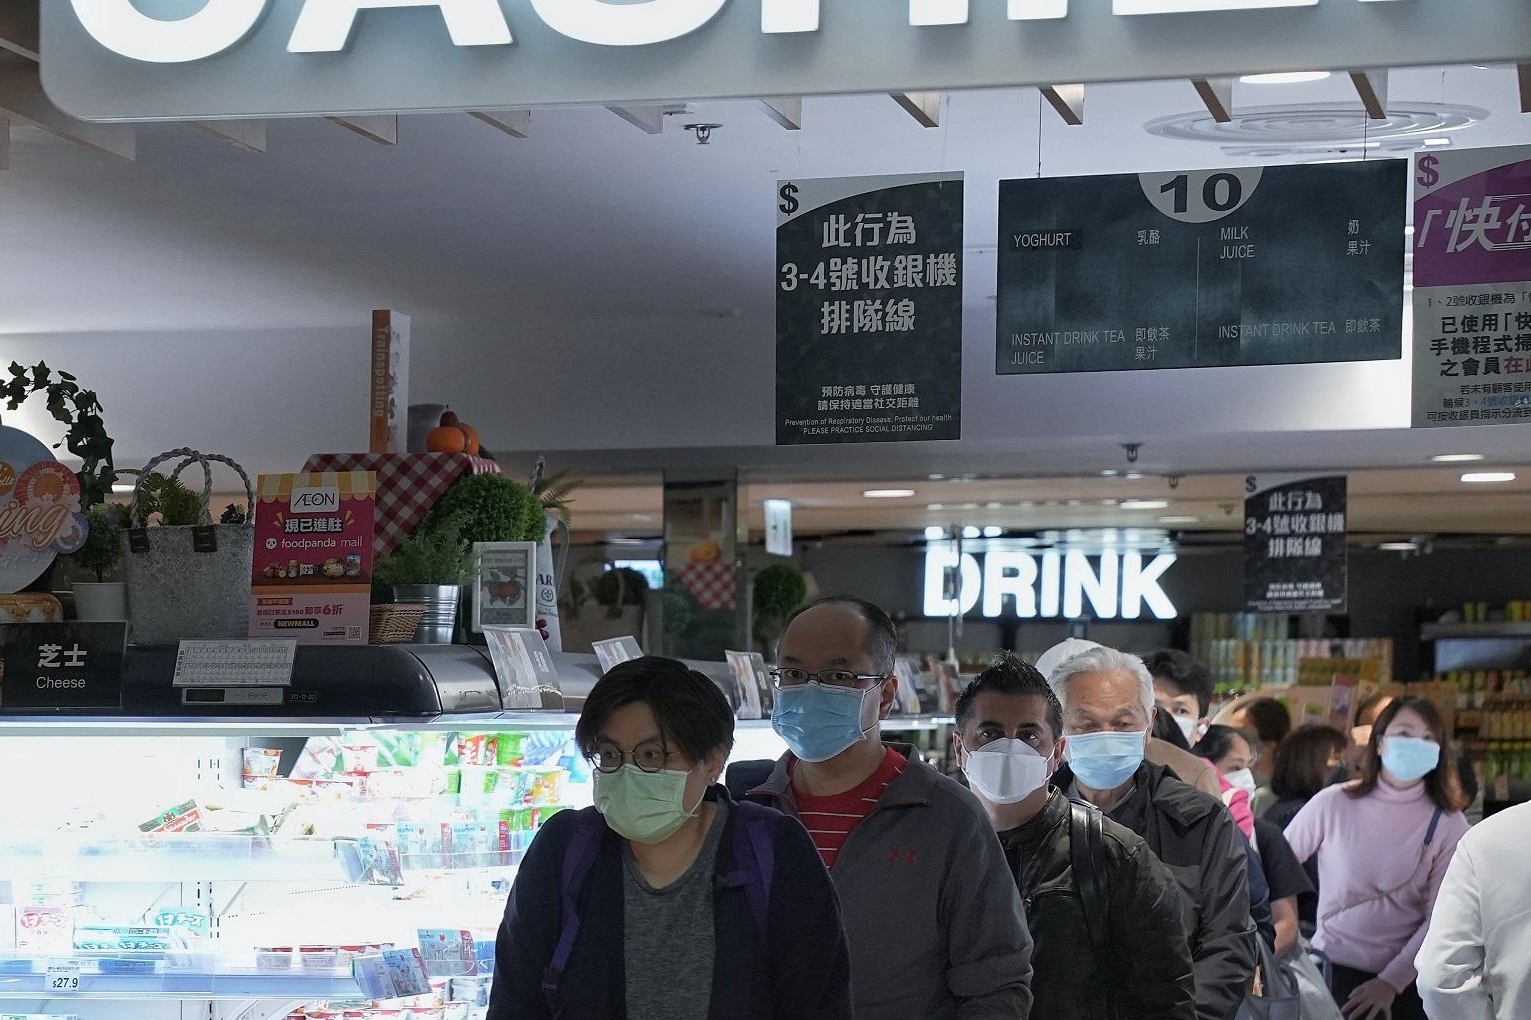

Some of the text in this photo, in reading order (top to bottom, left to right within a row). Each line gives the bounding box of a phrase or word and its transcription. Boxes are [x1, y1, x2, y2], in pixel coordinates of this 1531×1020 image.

[1417, 153, 1439, 189] $
[779, 182, 799, 216] $
[1160, 172, 1242, 213] 10
[822, 212, 917, 248] 此行為
[1221, 226, 1249, 241] MILK
[1347, 219, 1359, 236] 奶
[1013, 232, 1071, 247] YOGHURT
[1137, 229, 1160, 246] 乳酪
[1220, 245, 1255, 259] JUICE
[1347, 240, 1371, 256] 果汁
[781, 253, 957, 291] 3-4號收銀機
[1428, 292, 1531, 308] 1、2號收銀機為「
[821, 299, 916, 334] 排隊線
[1219, 321, 1336, 339] INSTANT DRINK TEA
[1345, 318, 1381, 334] 即飲茶
[1012, 329, 1125, 346] INSTANT DRINK TEA
[1135, 327, 1170, 342] 即飲茶
[1012, 351, 1045, 365] JUICE
[1135, 346, 1158, 361] 果汁
[373, 323, 389, 417] Trainspotting
[821, 384, 915, 397] 預防病毒 守護健康
[818, 397, 919, 411] 請保持適當社交距離
[785, 418, 819, 426] Prevention
[828, 417, 864, 426] Respiratory
[895, 415, 918, 423] Protect
[831, 426, 863, 434] PRACTICE
[866, 425, 890, 433] SOCIAL
[281, 536, 363, 550] foodpanda mall
[923, 550, 1178, 620] DRINK
[38, 643, 87, 668] 芝士
[36, 676, 86, 689] Cheese
[53, 977, 78, 988] $27.9
